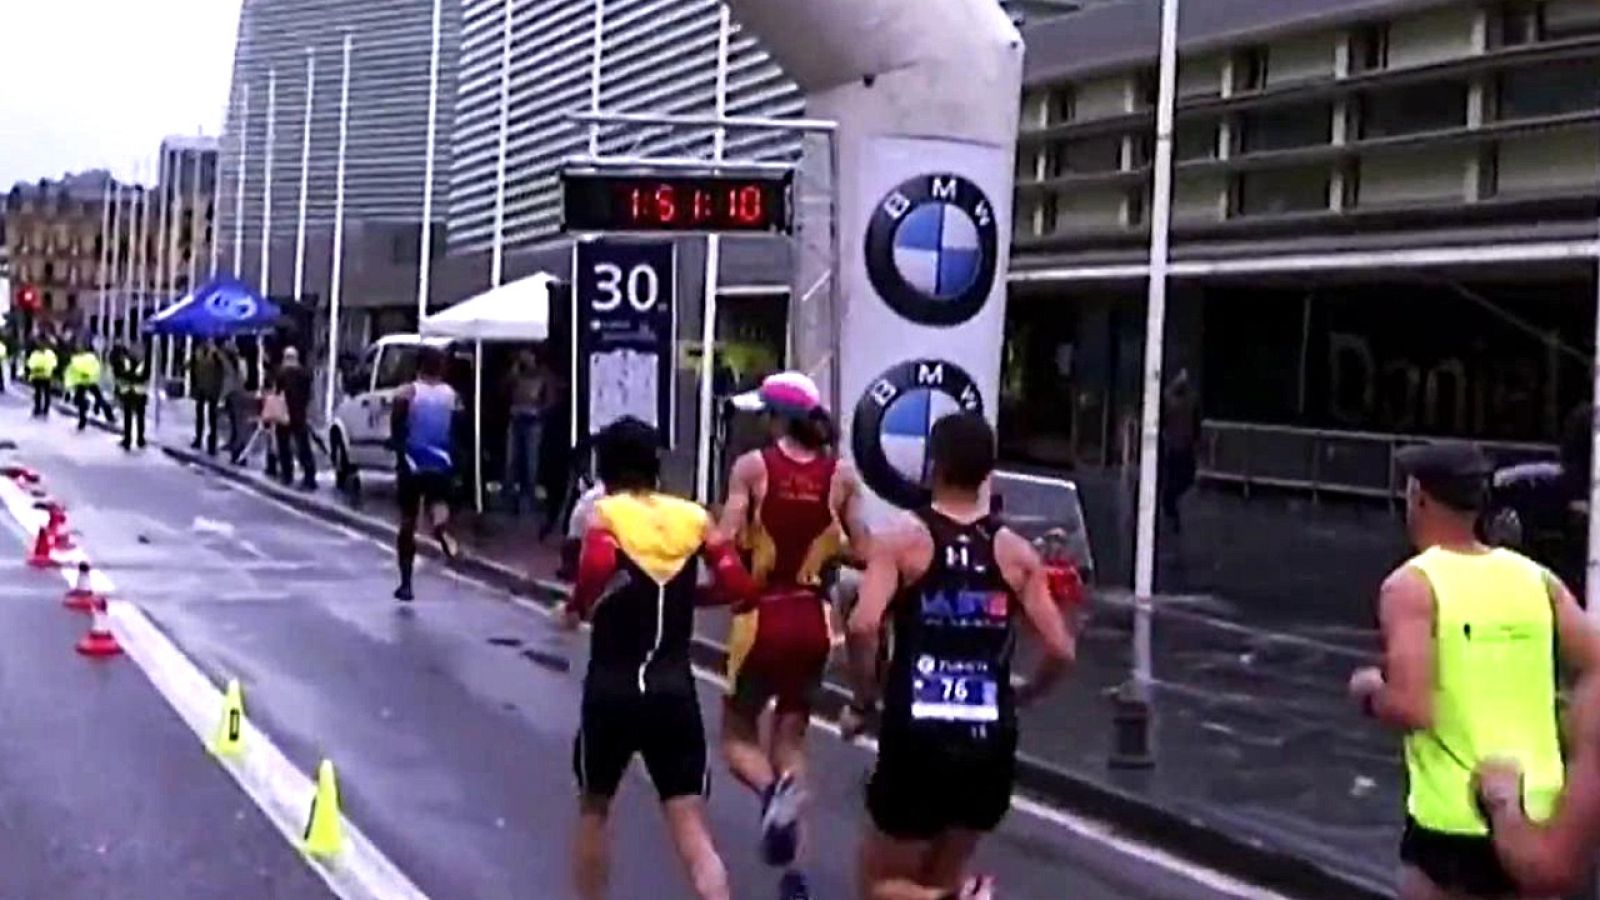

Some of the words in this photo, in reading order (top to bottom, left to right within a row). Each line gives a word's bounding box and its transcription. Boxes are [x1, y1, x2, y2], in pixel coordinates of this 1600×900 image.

[883, 176, 991, 227] BMW
[591, 264, 659, 312] 30
[869, 363, 978, 410] BMW
[940, 677, 969, 701] 76
